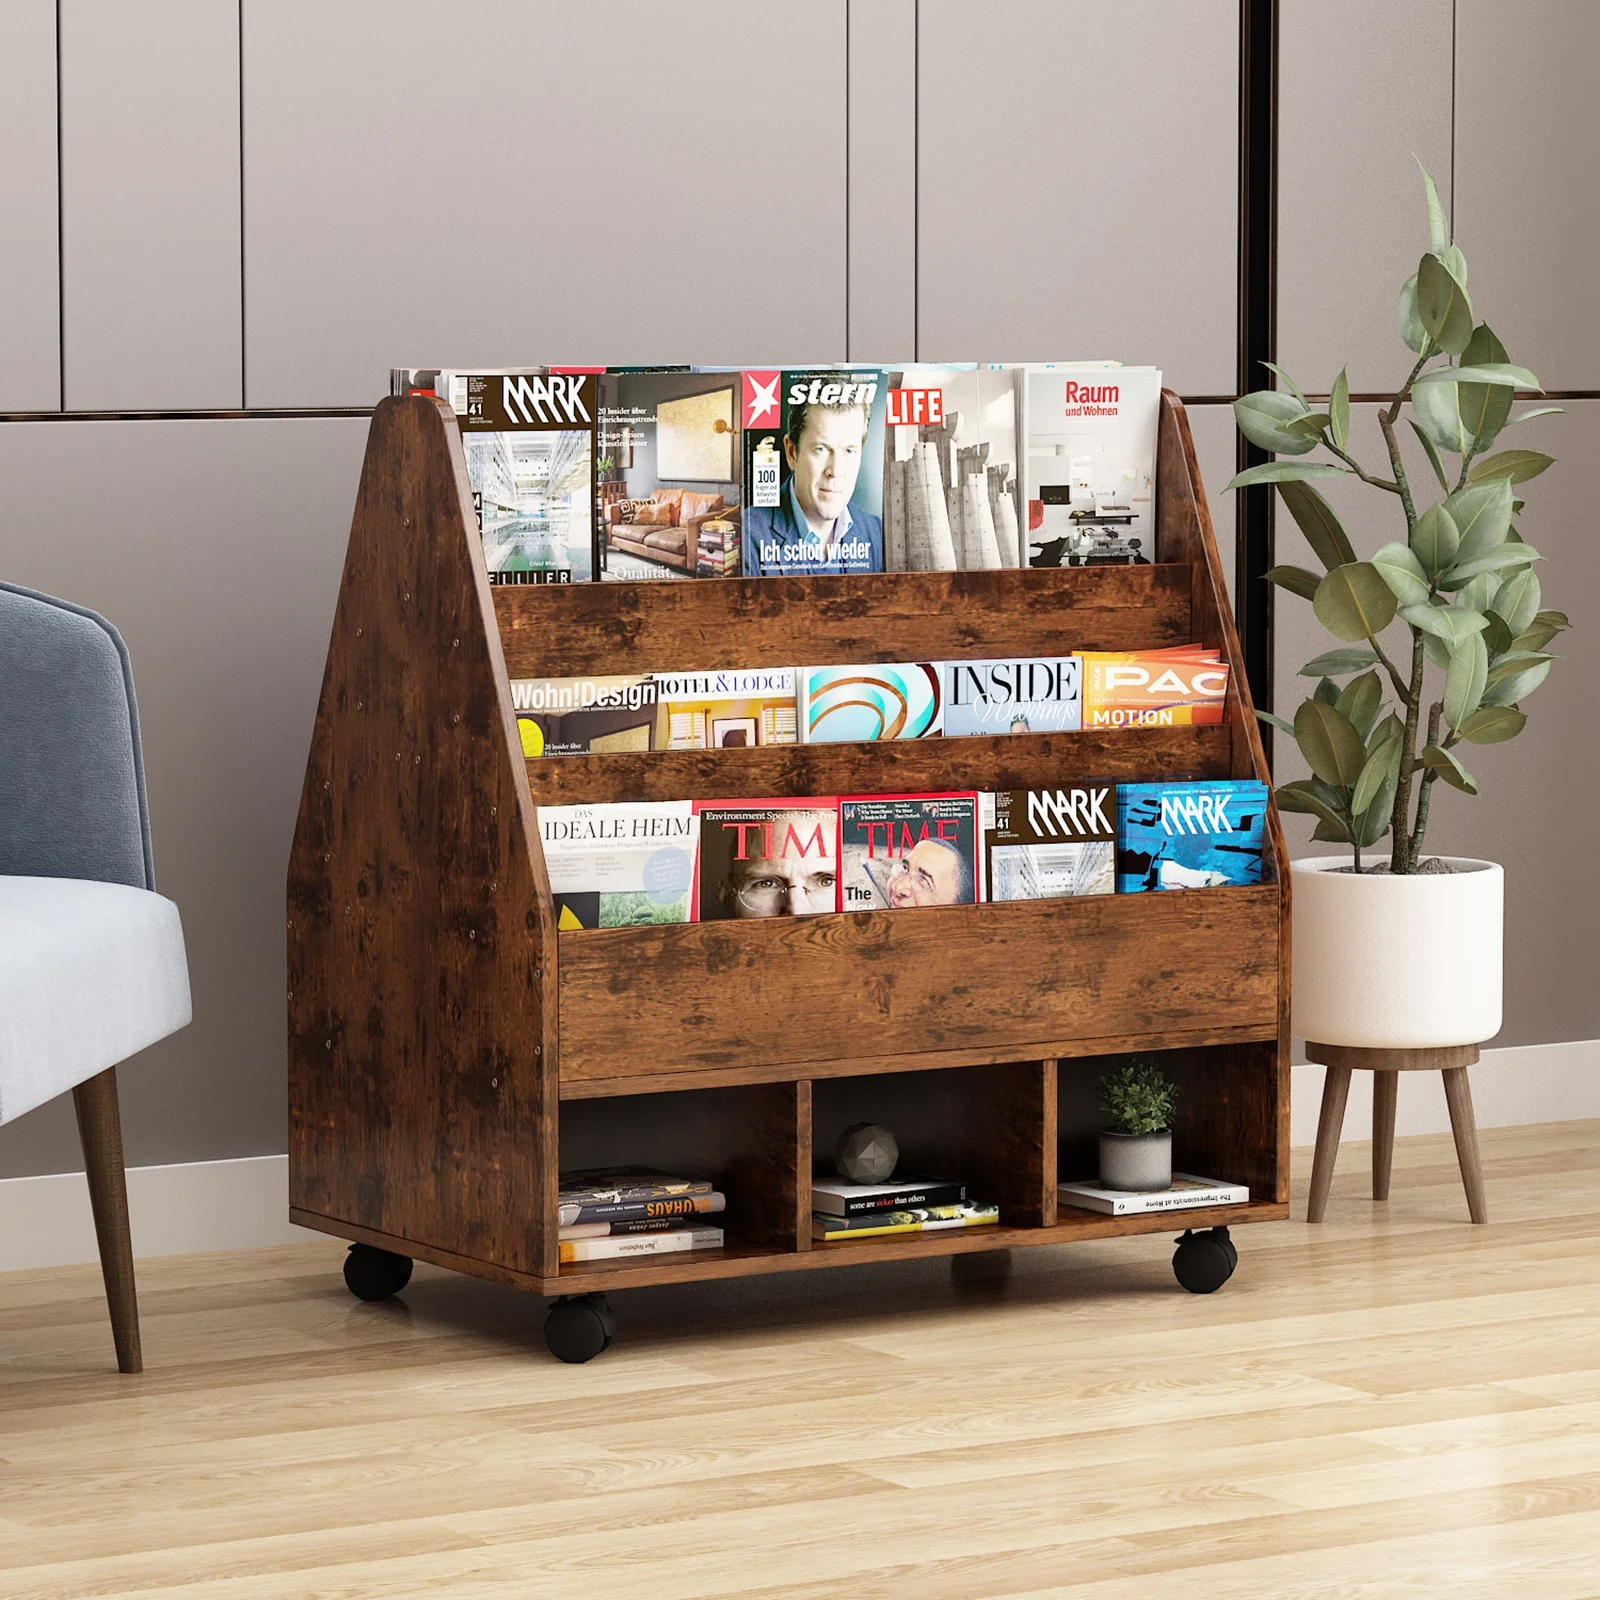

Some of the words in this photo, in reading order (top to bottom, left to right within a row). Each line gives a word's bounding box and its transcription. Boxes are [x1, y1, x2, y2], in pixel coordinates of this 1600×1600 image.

[502, 374, 592, 424] MARK
[787, 379, 878, 405] stern
[1065, 381, 1119, 404] Raum
[469, 403, 482, 415] 41
[607, 407, 630, 415] Insider
[631, 406, 647, 415] über
[887, 390, 942, 424] LIFE
[1065, 406, 1082, 417] und
[1083, 405, 1118, 416] Wohnen
[758, 470, 776, 483] 100
[760, 540, 780, 562] Ich
[784, 538, 824, 561] schon
[826, 537, 871, 560] wieder
[614, 566, 675, 580] Qualität,
[949, 662, 1077, 706] INSIDE
[511, 682, 655, 710] Wohn!Design
[973, 692, 1076, 730] Weddings
[1093, 709, 1173, 725] MOTION
[574, 809, 593, 819] DAS
[706, 812, 765, 820] Environment
[1028, 788, 1114, 837] MARK
[1161, 795, 1234, 835] MARK
[545, 819, 626, 840] IDEALE
[632, 817, 691, 837] HEIM
[997, 818, 1009, 829] 41
[857, 820, 959, 858] TIME
[845, 887, 872, 900] The
[647, 1199, 711, 1216] BAUHAUS
[850, 1201, 865, 1210] some
[876, 1198, 894, 1206] sicker
[895, 1196, 907, 1204] than
[908, 1195, 926, 1203] others
[1173, 1195, 1218, 1206] Impressionists
[619, 1243, 641, 1251] Nicholson
